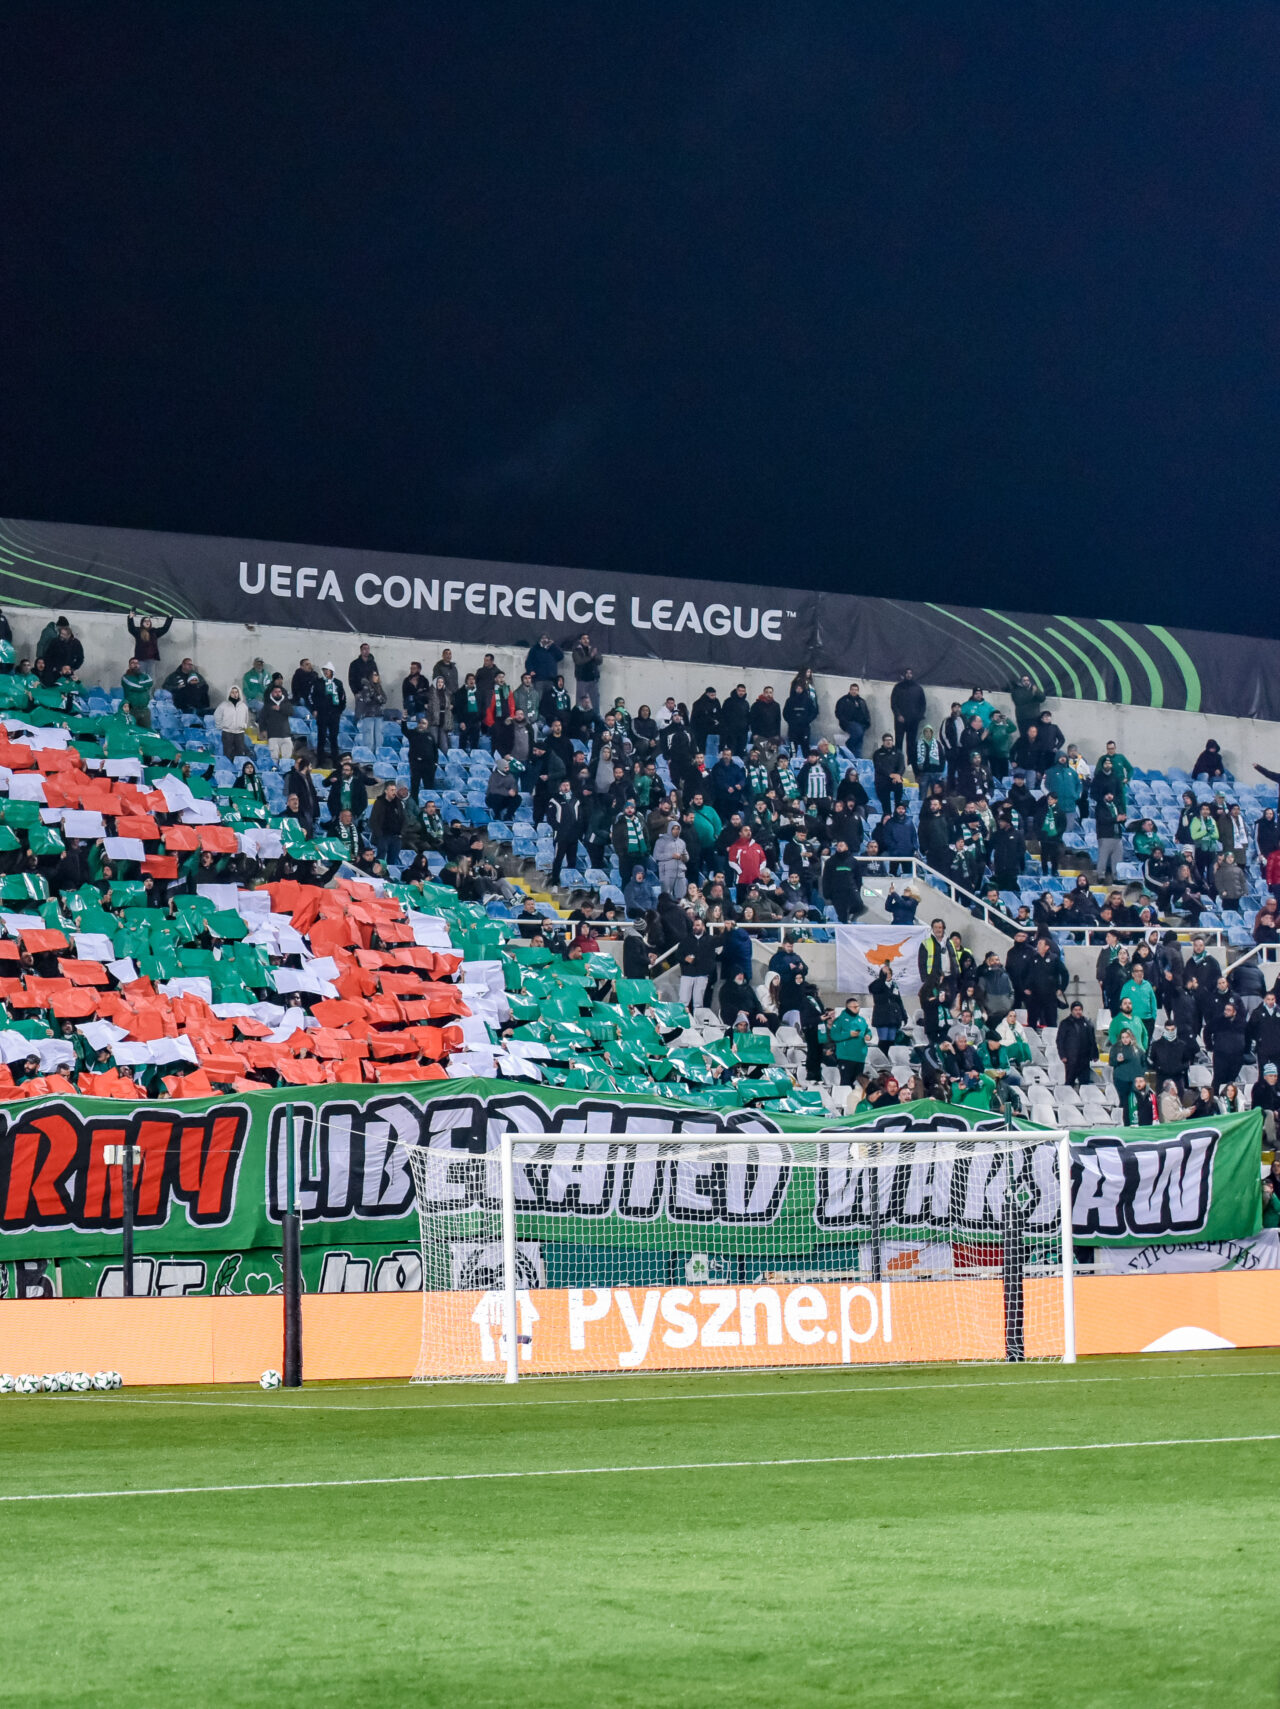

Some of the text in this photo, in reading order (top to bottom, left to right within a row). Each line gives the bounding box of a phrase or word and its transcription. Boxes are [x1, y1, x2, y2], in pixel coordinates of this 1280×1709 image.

[239, 562, 344, 603] UEFA
[354, 572, 616, 626] CONFERENCE
[631, 597, 783, 641] LEAGUE
[268, 1094, 791, 1224] LIBERATED
[816, 1112, 1219, 1238] WARSAW
[567, 1282, 893, 1368] Pyszne.pl
